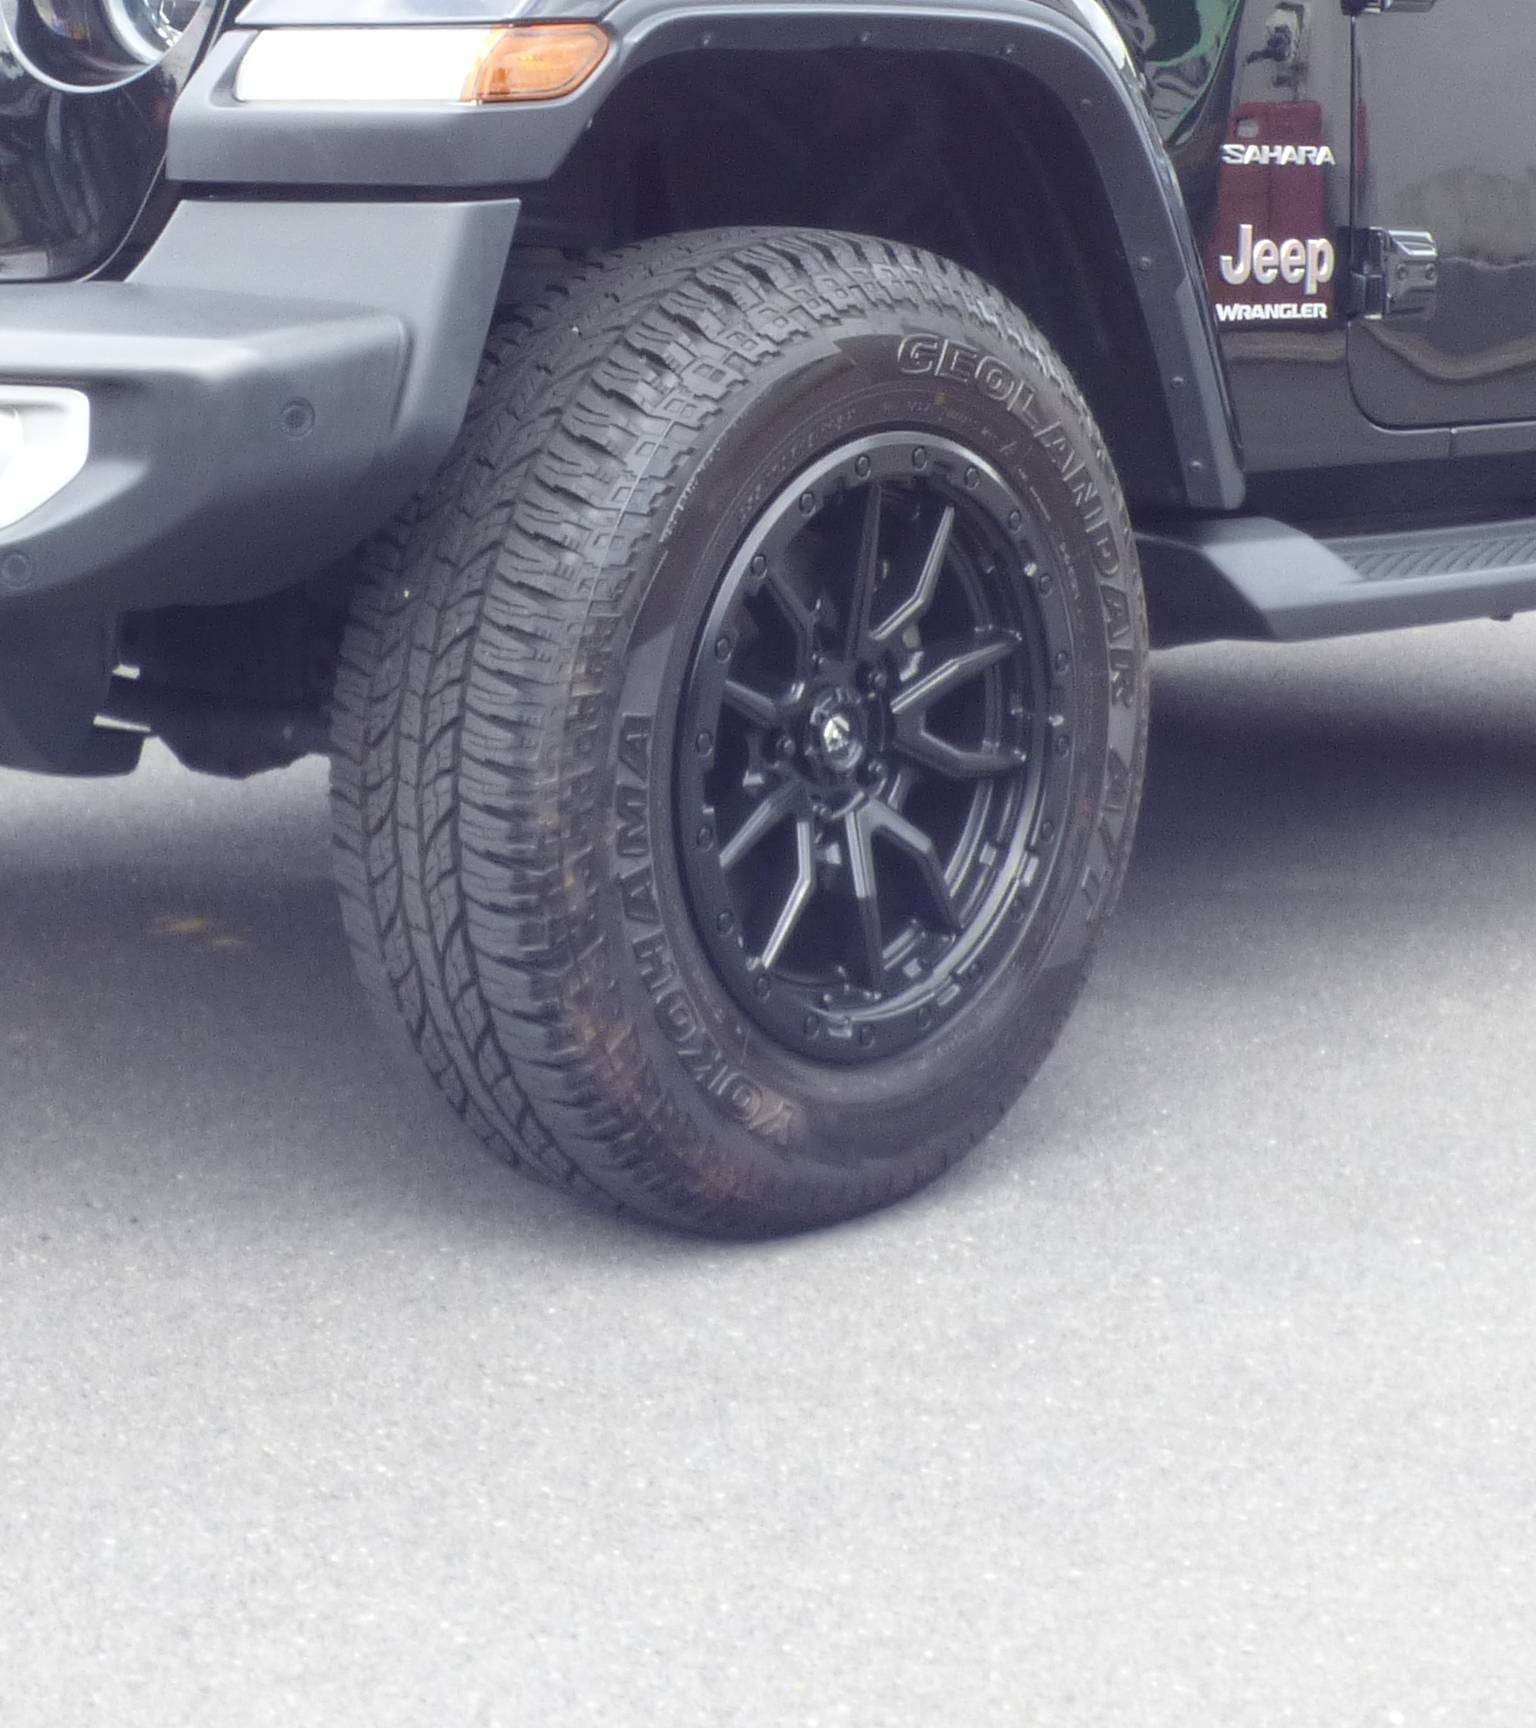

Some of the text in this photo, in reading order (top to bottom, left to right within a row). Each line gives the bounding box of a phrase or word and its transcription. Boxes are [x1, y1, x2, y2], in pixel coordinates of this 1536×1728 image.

[1221, 144, 1335, 166] SAHARA
[1220, 224, 1334, 295] Jeep
[1215, 303, 1328, 321] WRANGLER
[897, 332, 1135, 709] GEOLANDAR
[616, 713, 802, 1134] YOKOHAMA
